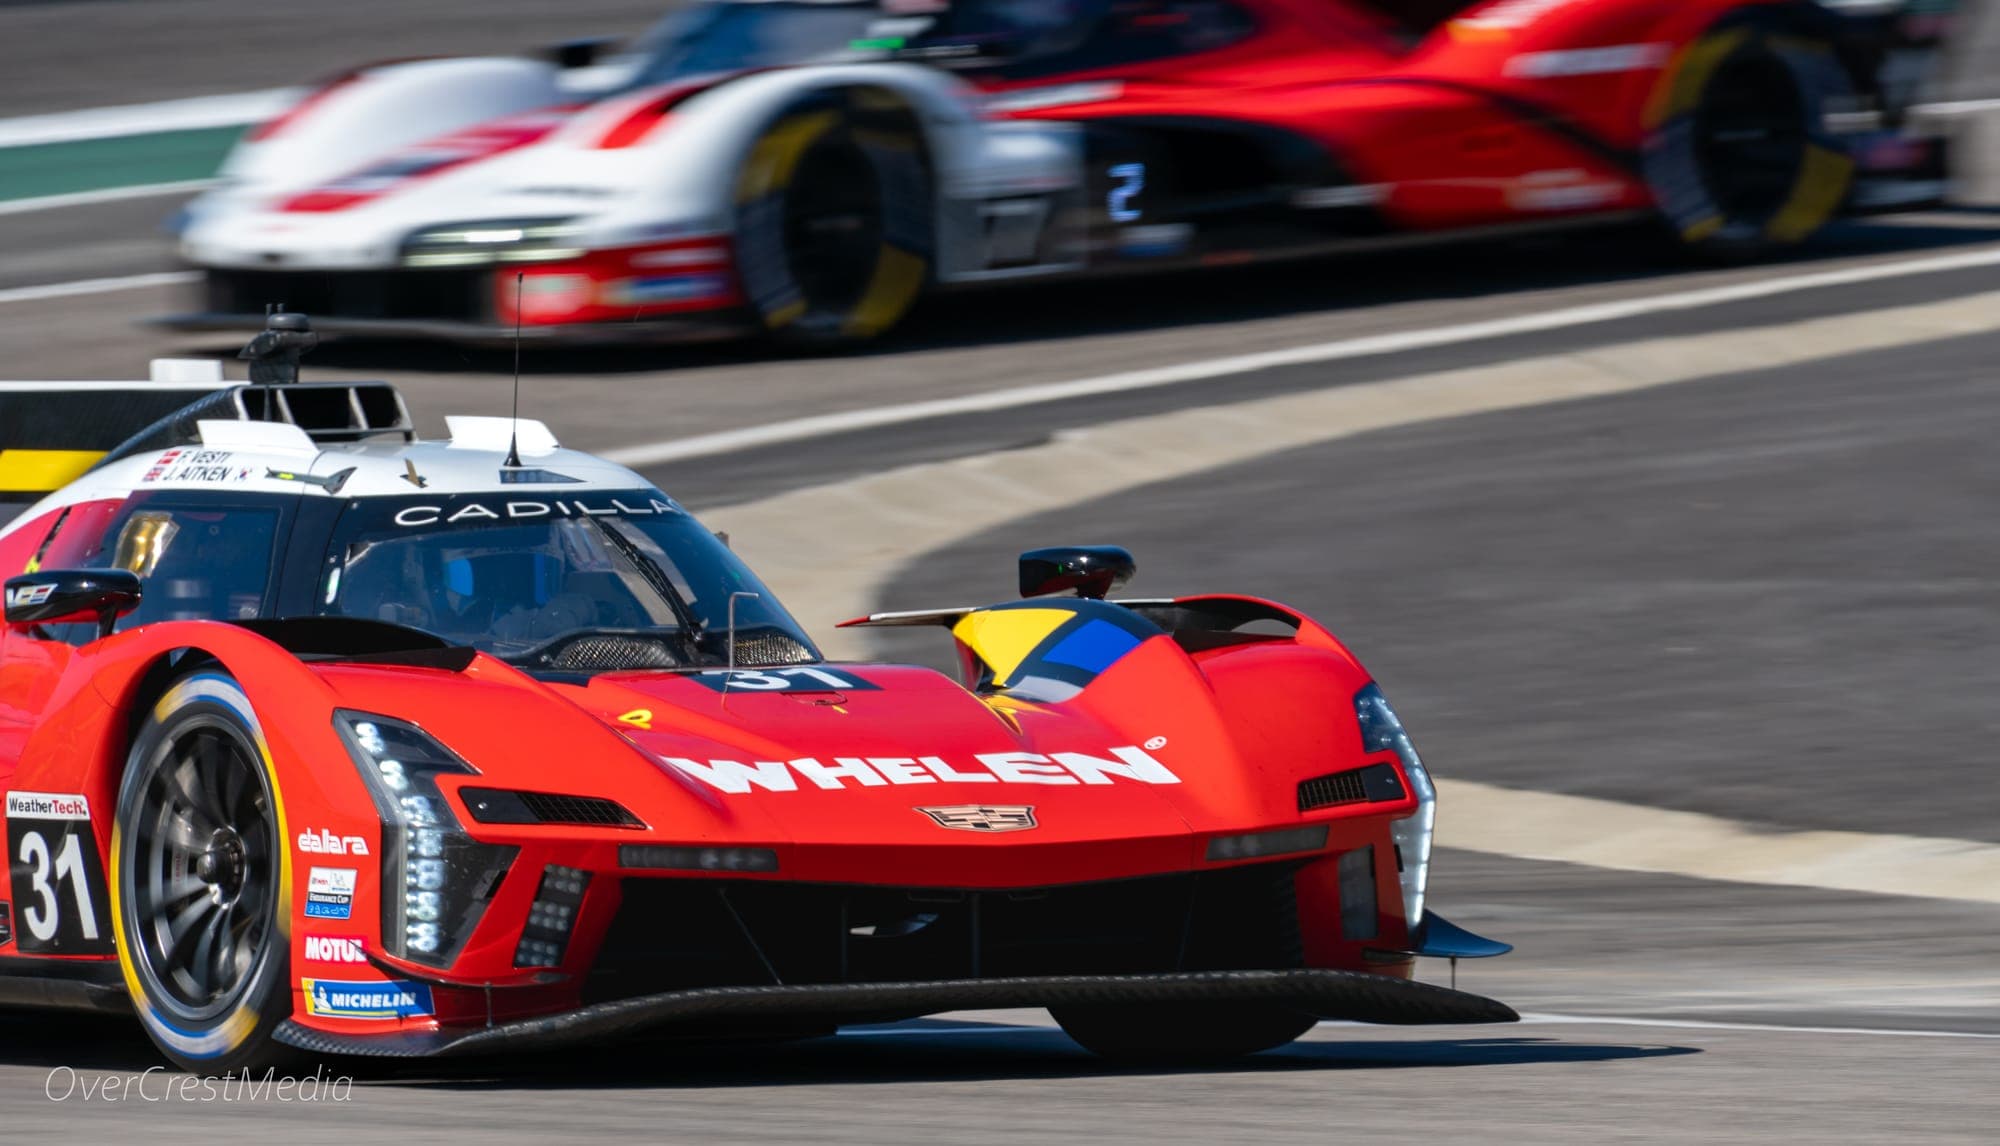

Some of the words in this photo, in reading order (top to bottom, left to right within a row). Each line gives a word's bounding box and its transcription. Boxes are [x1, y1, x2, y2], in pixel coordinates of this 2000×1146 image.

[191, 450, 233, 464] VESTI
[177, 466, 233, 481] AITKEN
[701, 667, 854, 690] 31
[298, 827, 370, 856] dallara
[19, 831, 99, 941] 31
[331, 991, 417, 1008] MICHELIN
